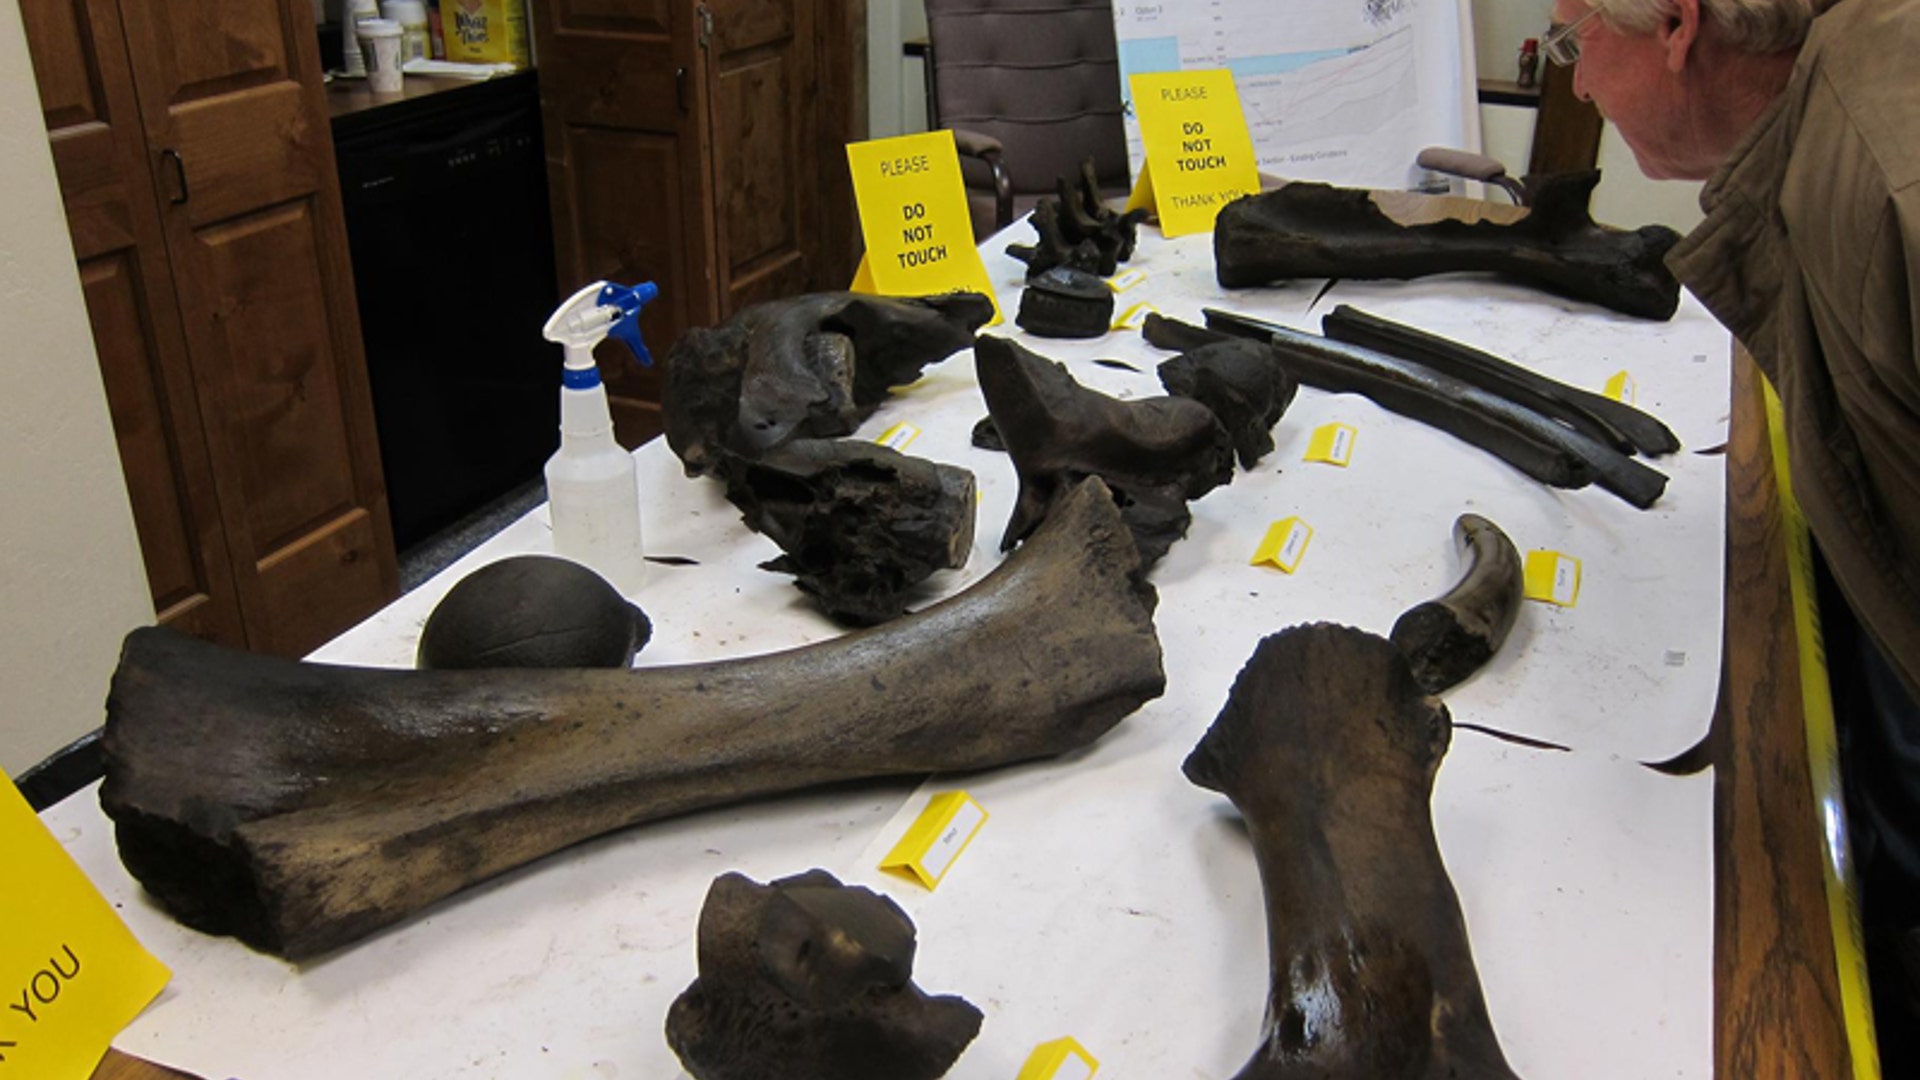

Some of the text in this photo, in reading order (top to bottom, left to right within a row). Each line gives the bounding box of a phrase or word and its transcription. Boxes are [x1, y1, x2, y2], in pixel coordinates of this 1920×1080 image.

[1161, 86, 1208, 101] PLEASE
[1182, 122, 1204, 135] DO
[1182, 139, 1212, 152] NOT
[880, 156, 929, 177] PLEASE
[1177, 156, 1227, 171] TOUCH
[1171, 193, 1215, 208] THANK
[903, 203, 925, 220] DO
[903, 225, 933, 243] NOT
[897, 246, 947, 268] TOUCH
[9, 944, 80, 1022] YOU
